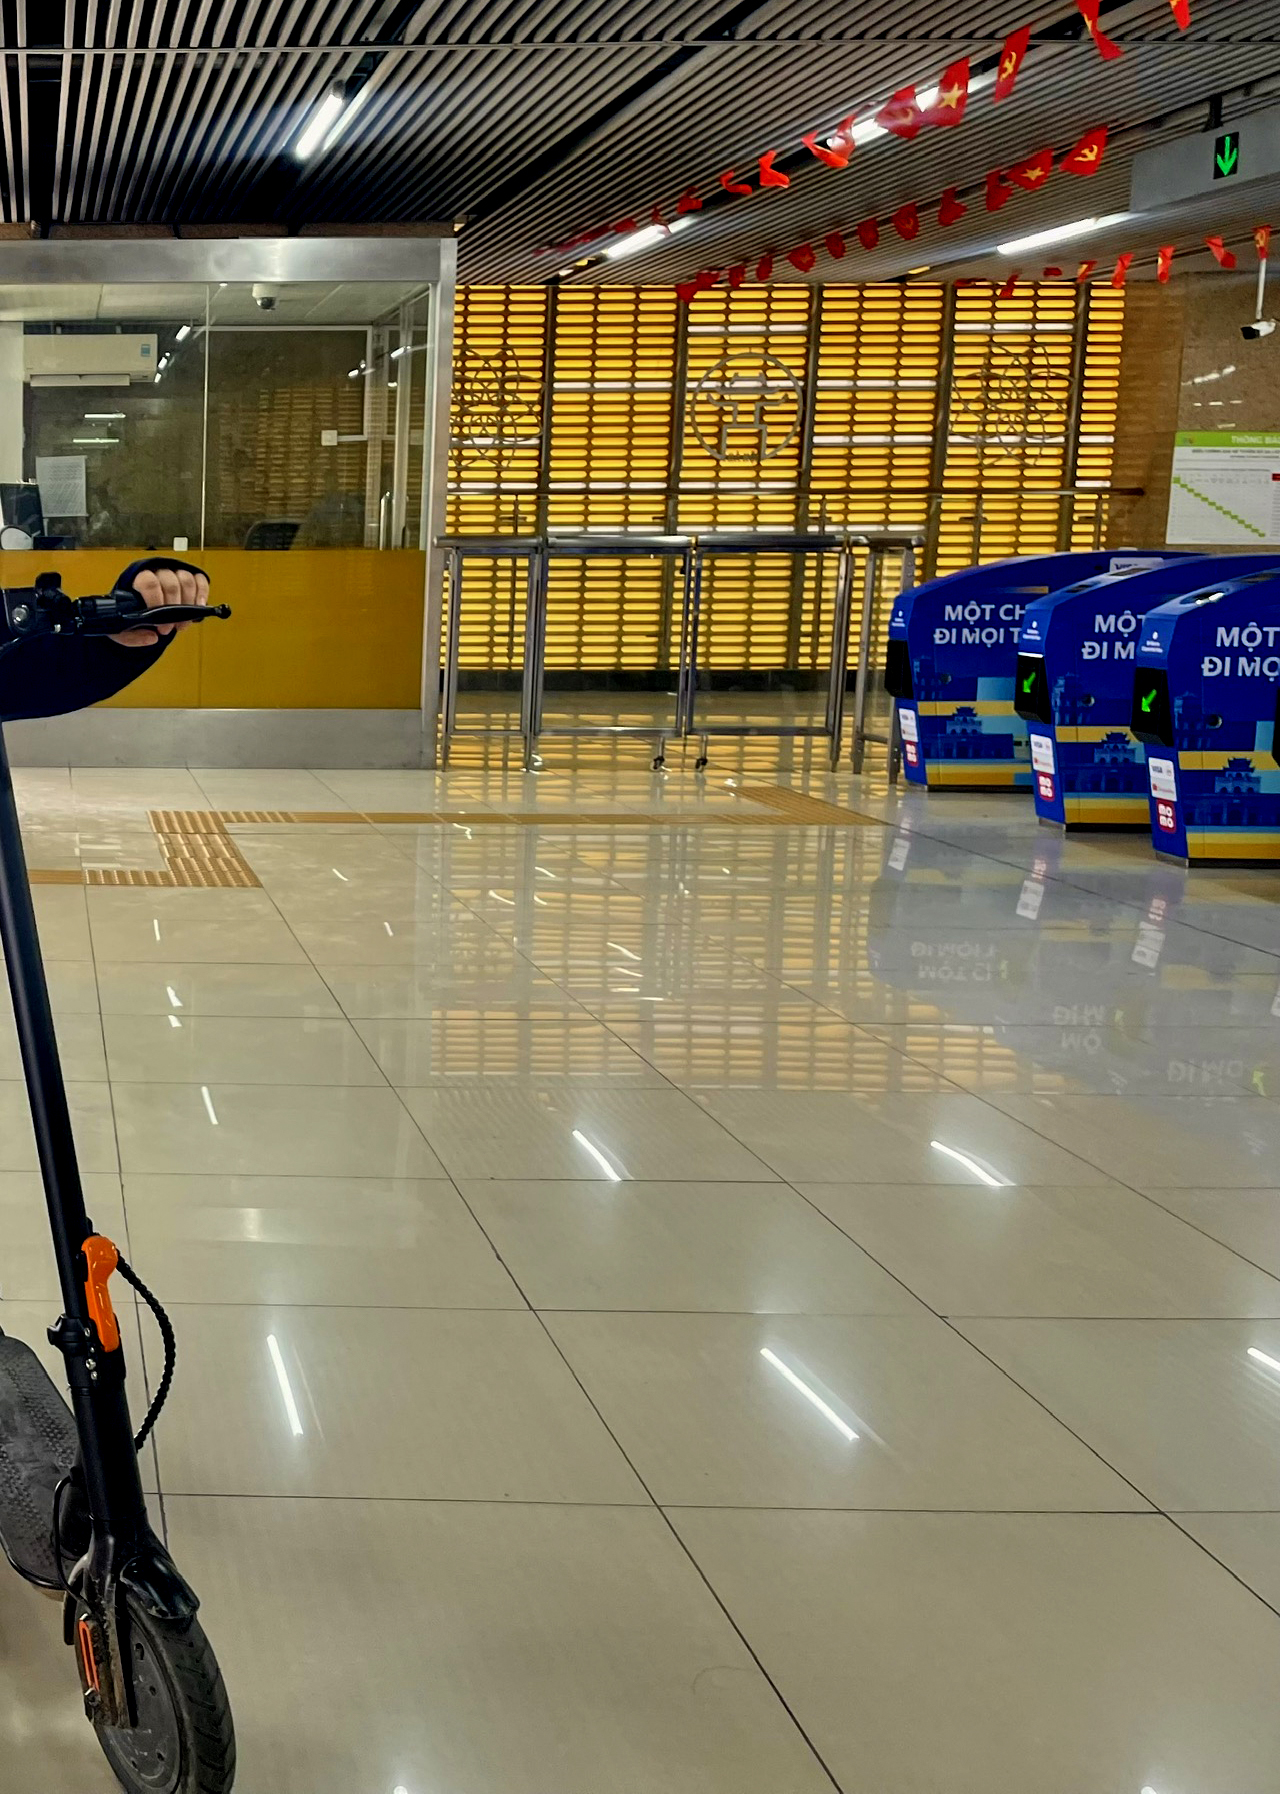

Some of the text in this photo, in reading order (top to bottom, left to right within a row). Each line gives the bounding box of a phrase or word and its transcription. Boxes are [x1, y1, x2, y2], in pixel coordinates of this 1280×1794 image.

[944, 600, 995, 625] MỘT
[933, 627, 957, 645] ĐI
[961, 627, 1005, 648] MỌI
[1216, 621, 1280, 653] MỘT
[1081, 641, 1108, 660] ĐI
[1201, 656, 1231, 677] ĐI
